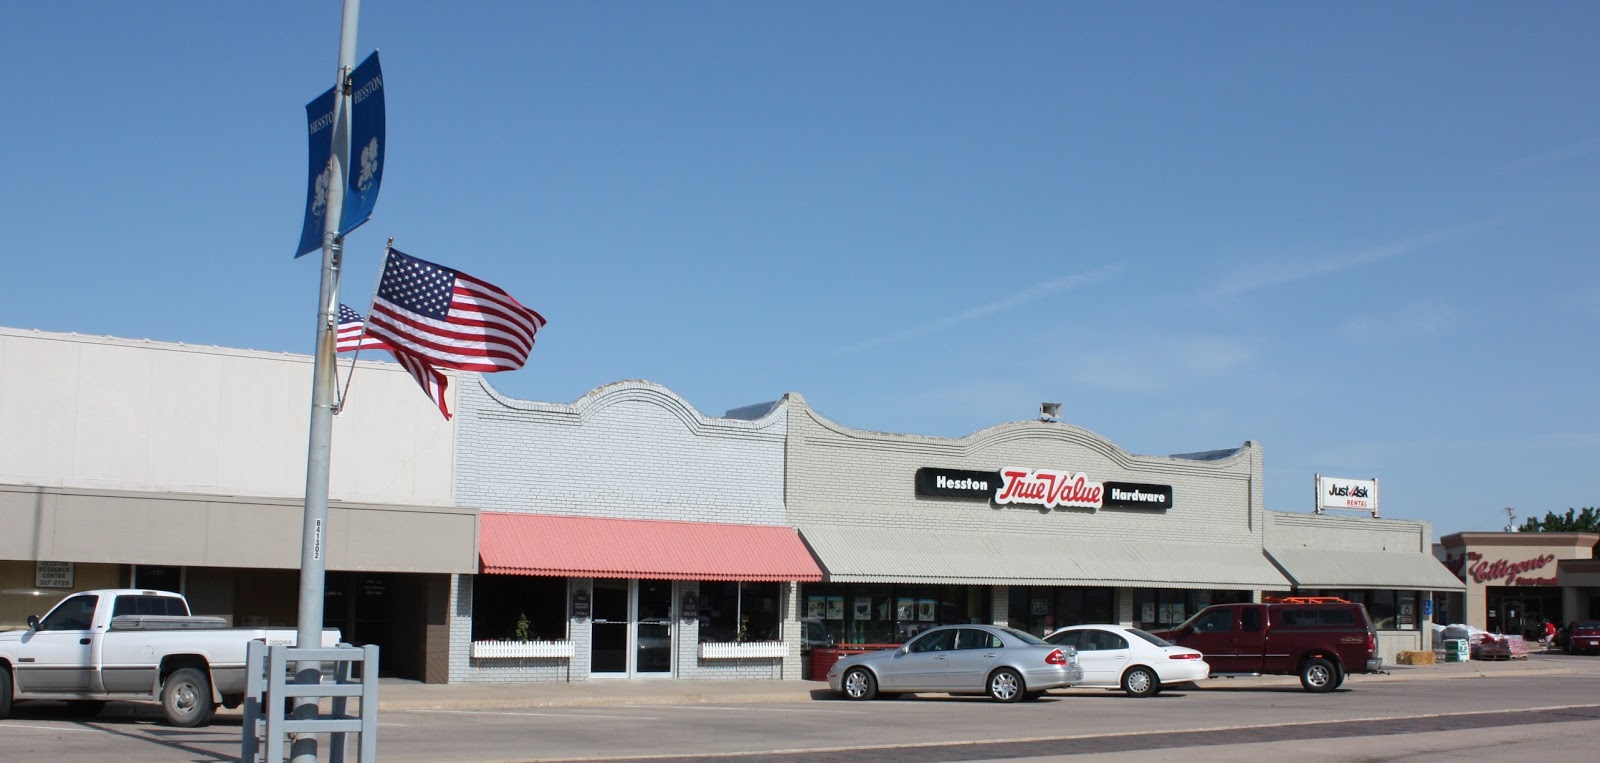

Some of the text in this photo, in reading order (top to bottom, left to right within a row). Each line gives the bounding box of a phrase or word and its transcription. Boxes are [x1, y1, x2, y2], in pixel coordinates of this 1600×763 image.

[354, 74, 382, 105] HESSTON
[310, 111, 334, 135] HESSTO
[936, 470, 1166, 504] Hesston True Value Hardware
[1328, 483, 1369, 498] Just Ask
[1346, 499, 1368, 507] RENTAL
[1470, 554, 1554, 585] Citizens
